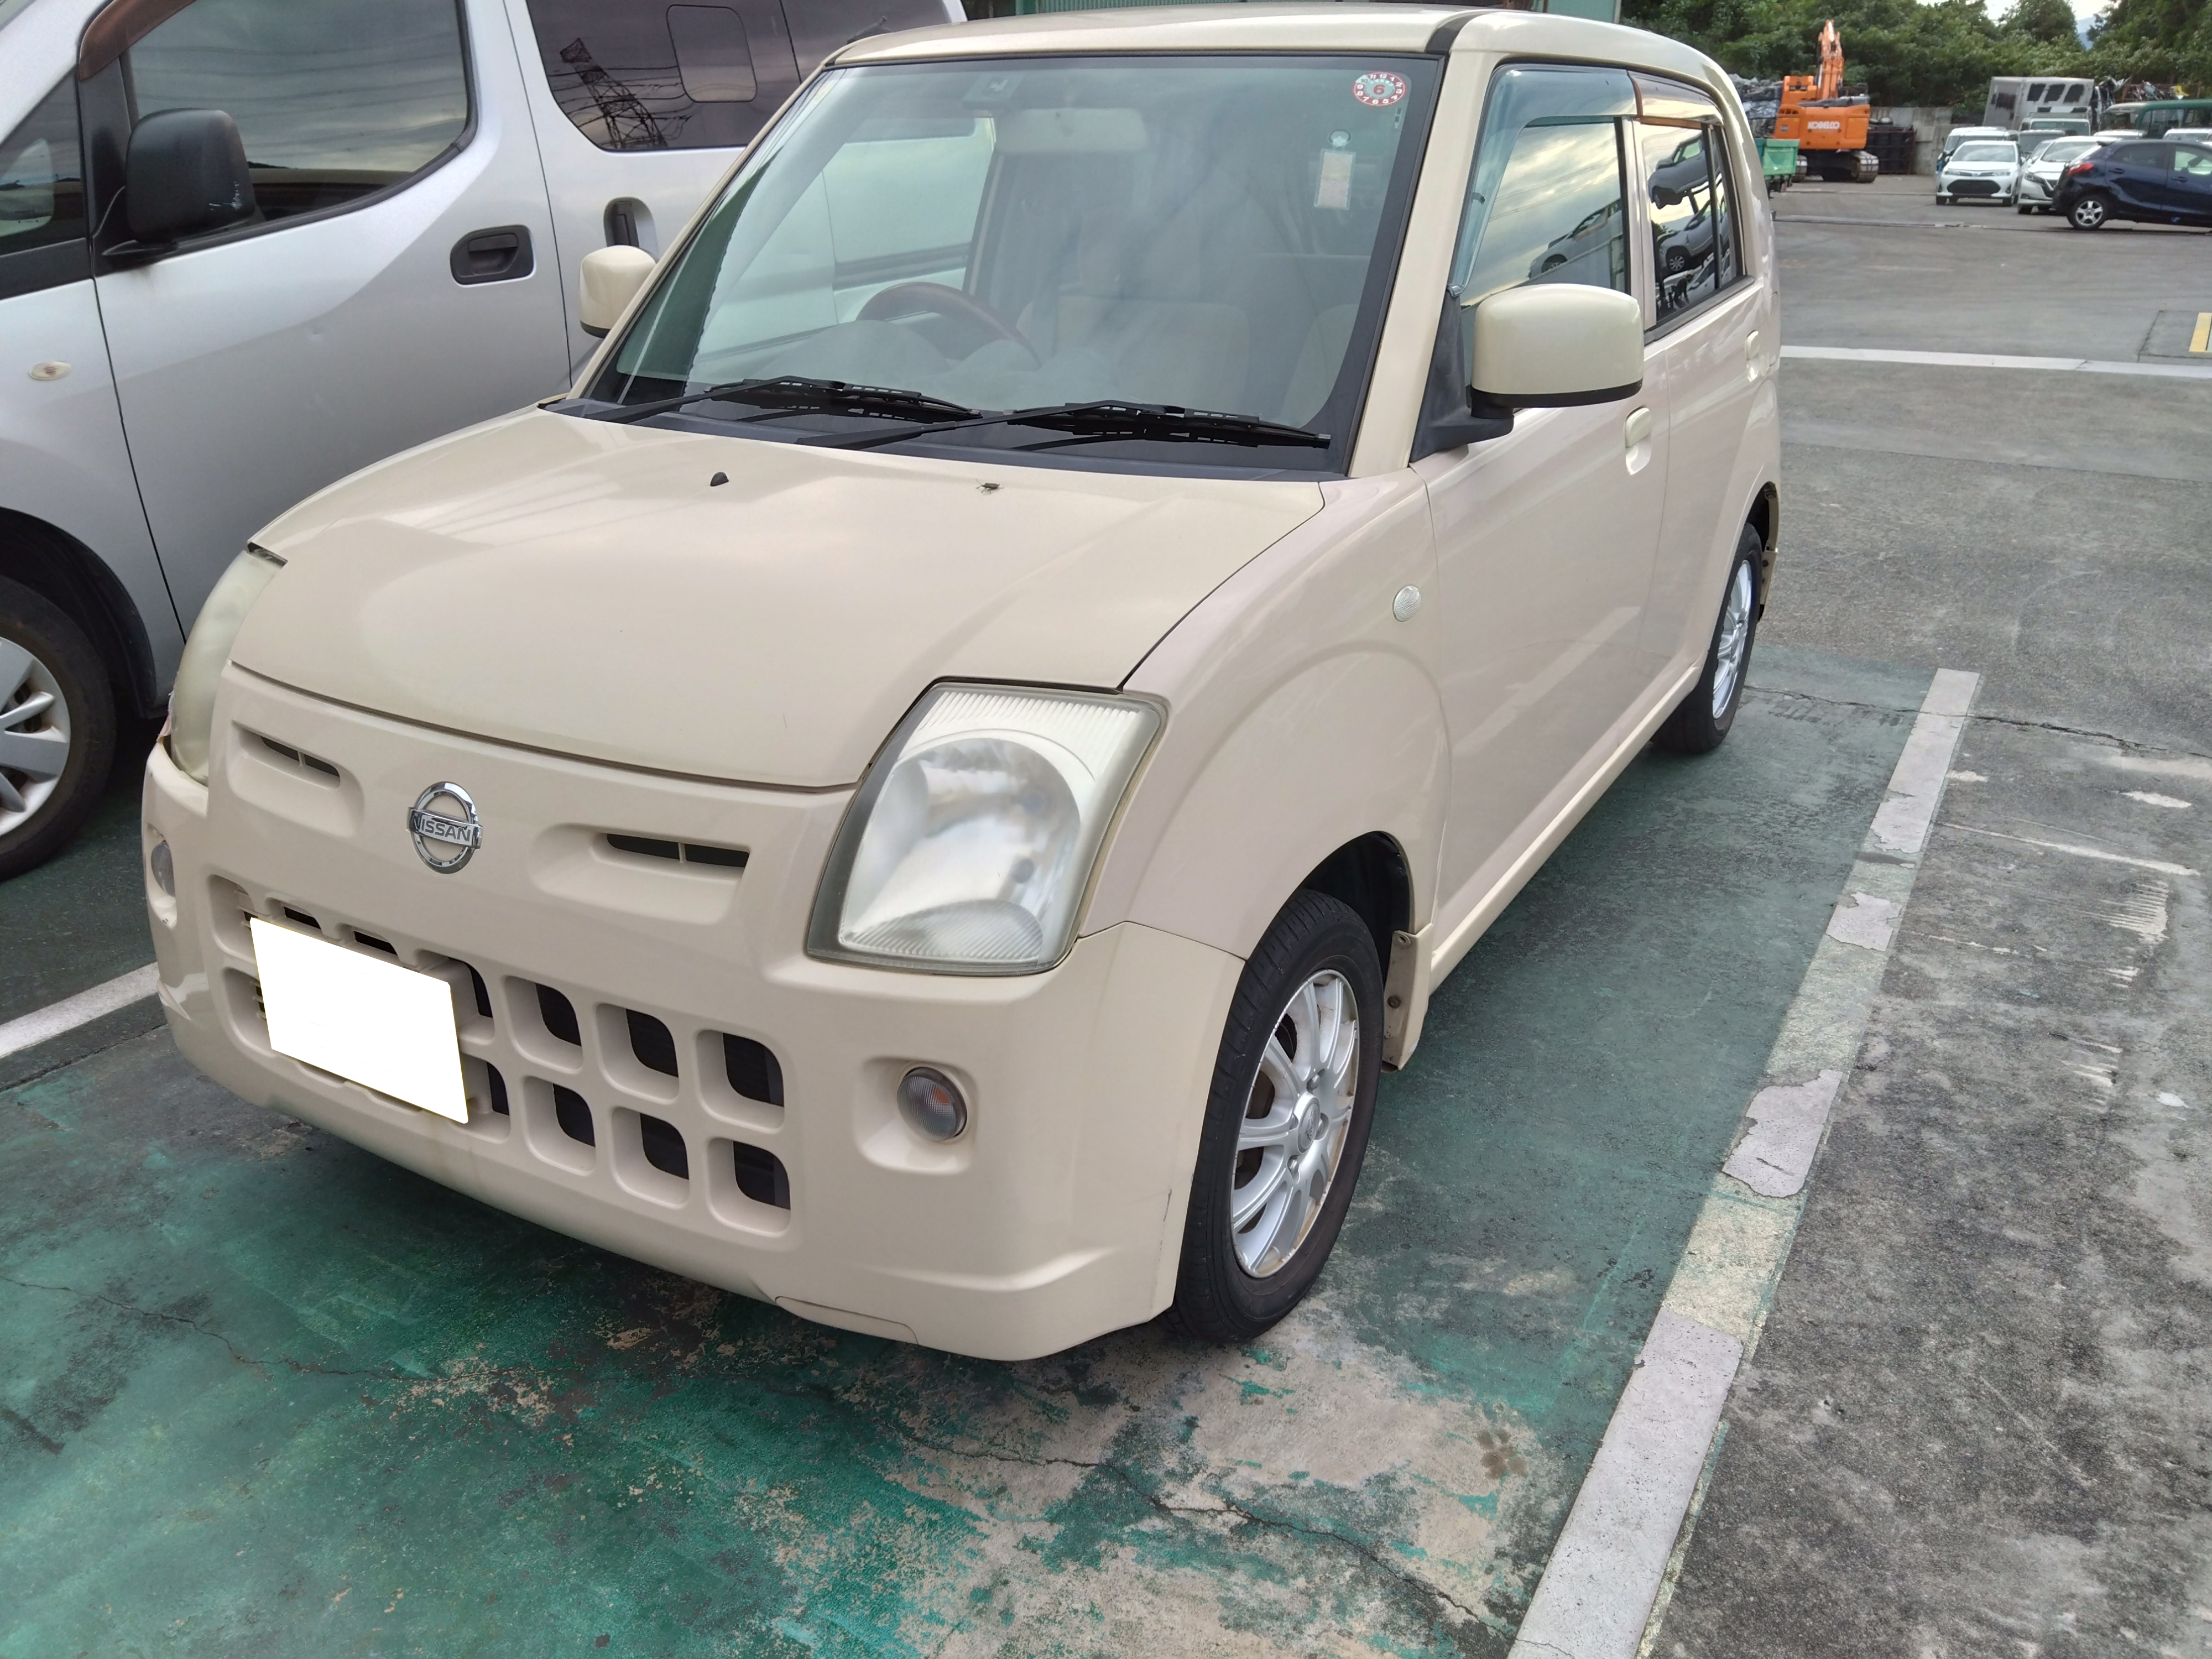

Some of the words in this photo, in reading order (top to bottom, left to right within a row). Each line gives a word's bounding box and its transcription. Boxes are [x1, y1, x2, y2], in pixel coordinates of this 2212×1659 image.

[1373, 84, 1385, 95] 6
[1807, 121, 1840, 129] KOBELCO
[413, 813, 471, 842] NISSAN
